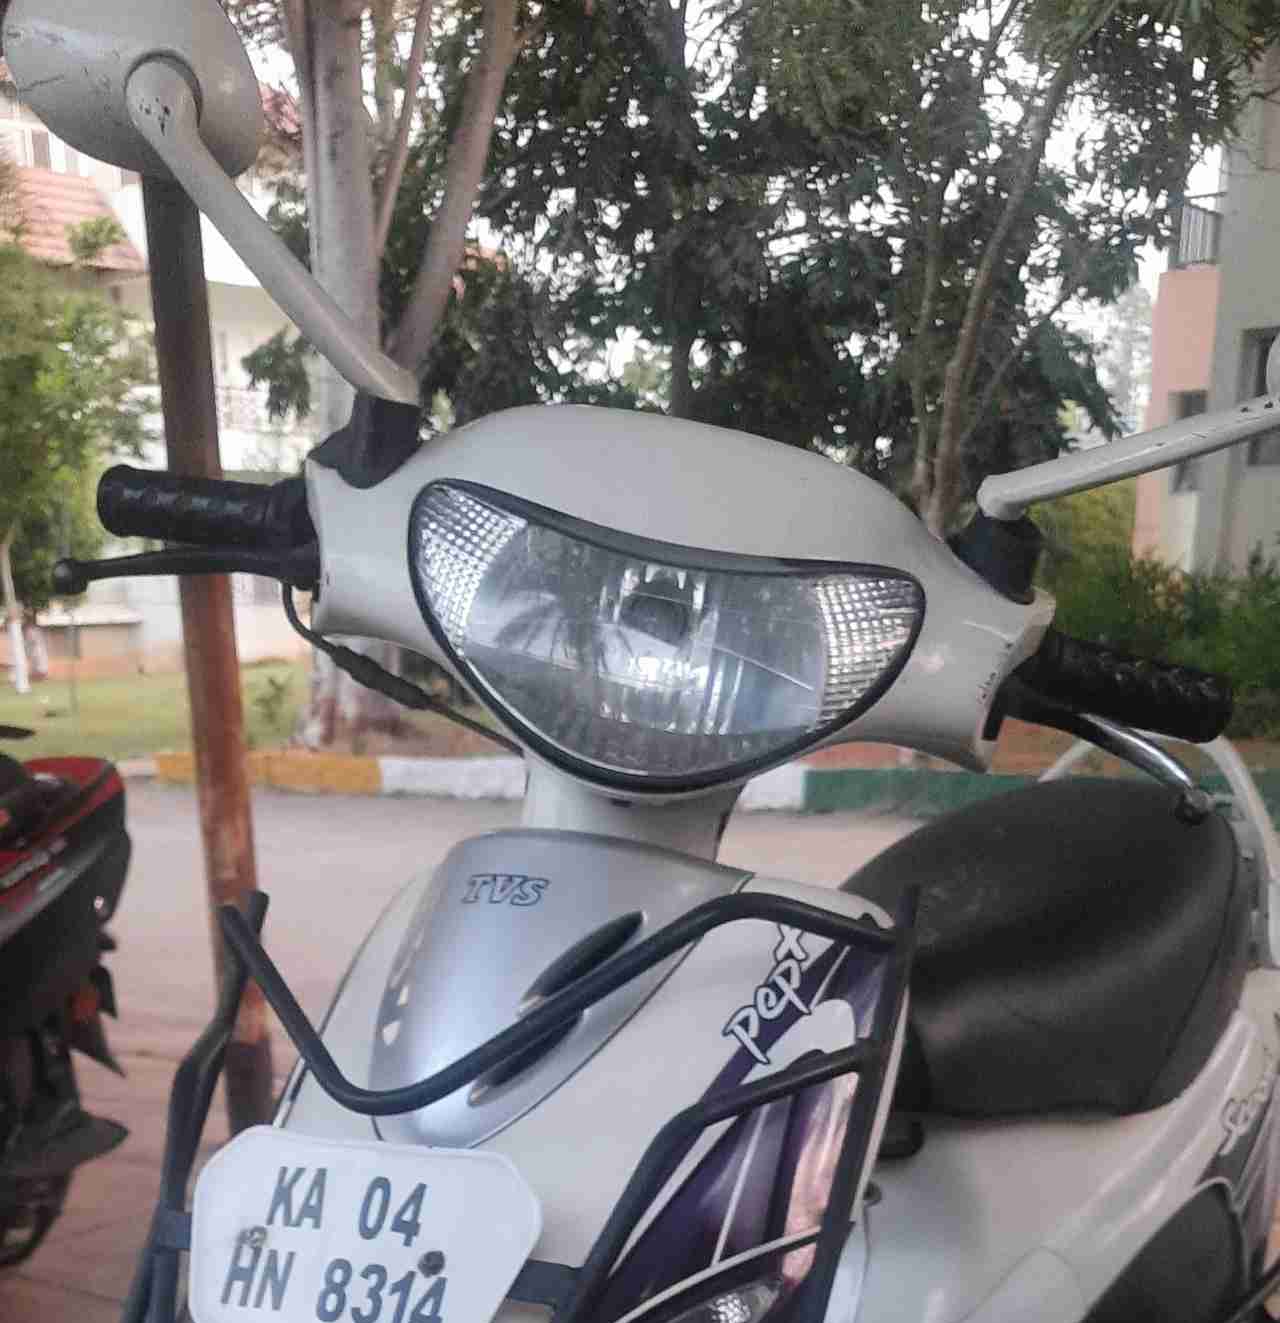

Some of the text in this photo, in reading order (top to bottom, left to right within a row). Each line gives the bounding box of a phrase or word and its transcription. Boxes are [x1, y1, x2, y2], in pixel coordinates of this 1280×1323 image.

[461, 873, 549, 906] TVS
[266, 1166, 426, 1246] KA 04
[221, 1238, 296, 1310] HN
